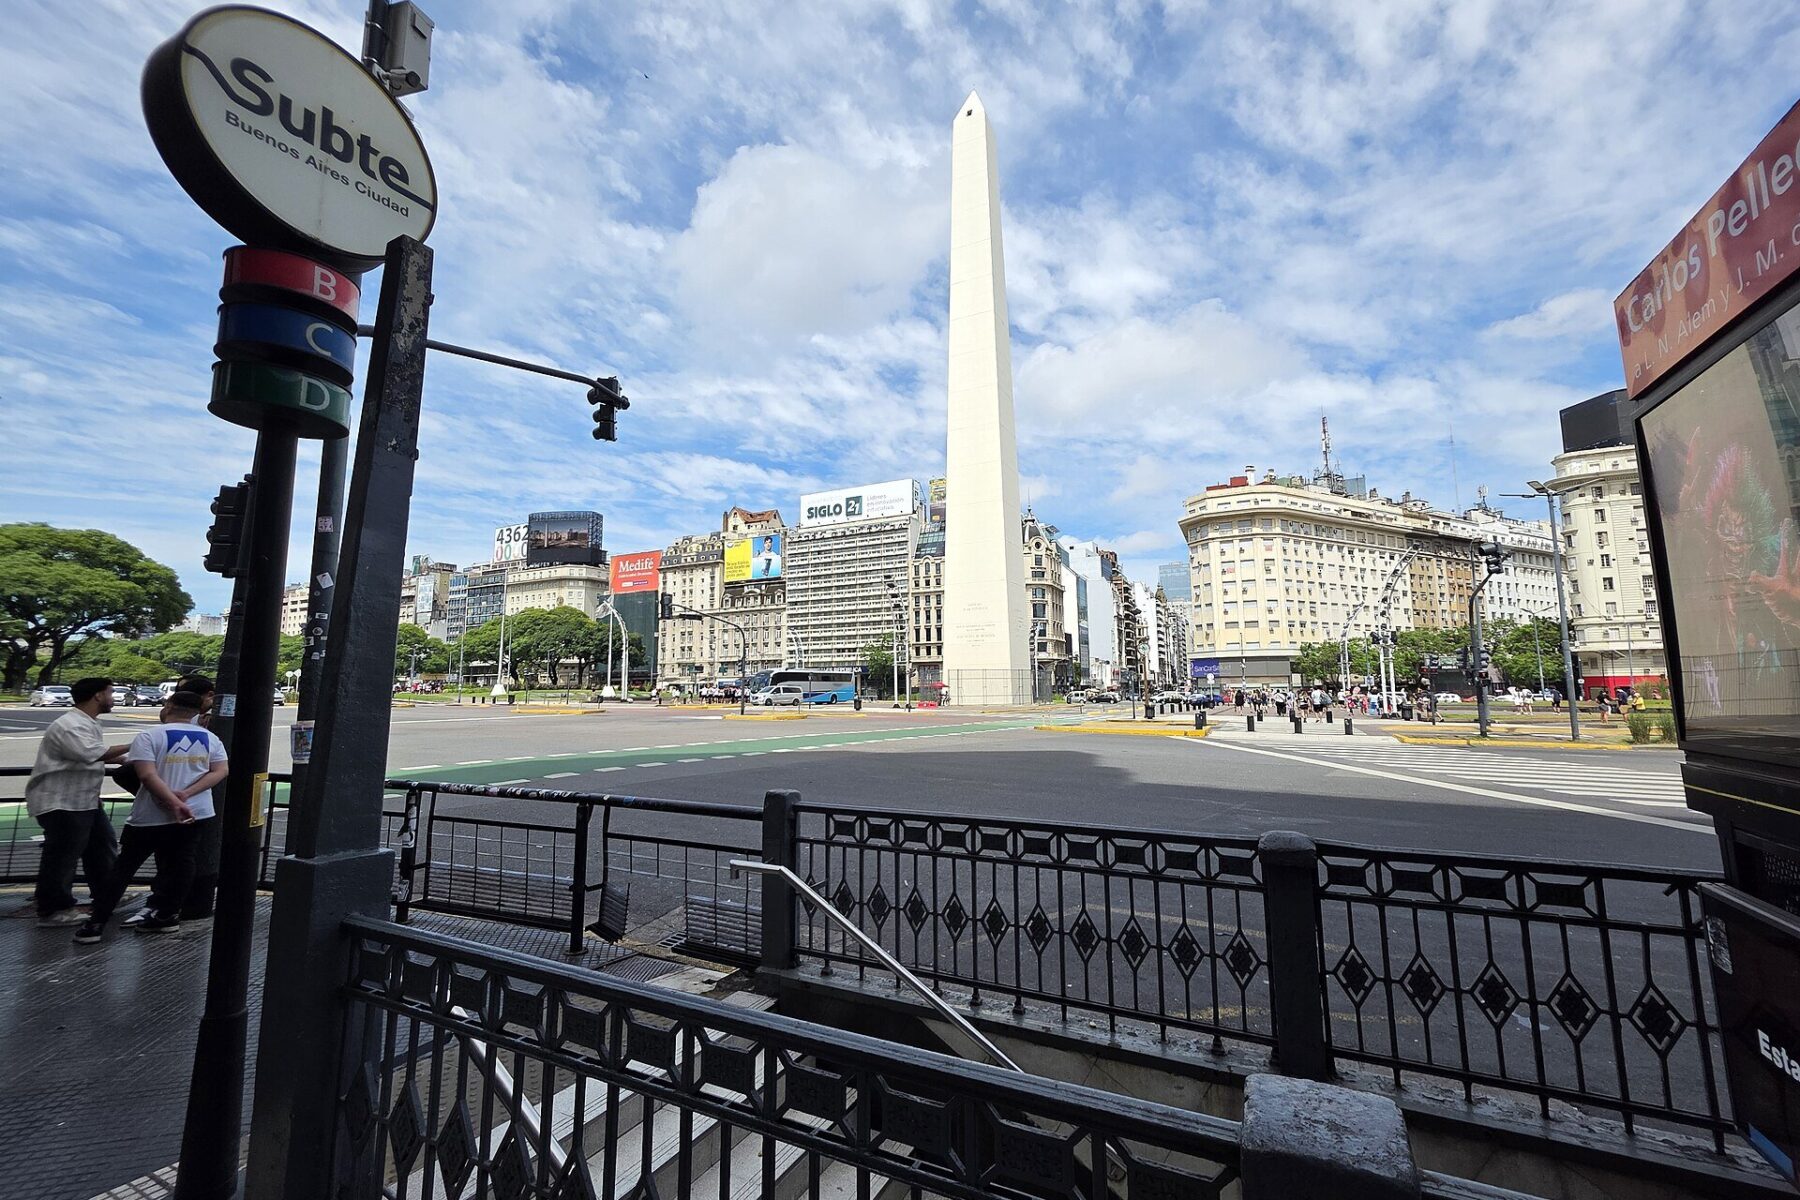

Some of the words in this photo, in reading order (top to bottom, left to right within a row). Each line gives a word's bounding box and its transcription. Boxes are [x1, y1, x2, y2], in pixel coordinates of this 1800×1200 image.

[226, 55, 412, 192] Subte
[225, 109, 300, 160] Buenos
[305, 154, 350, 186] Aires
[354, 180, 410, 218] Ciudad
[312, 265, 337, 302] B
[1626, 242, 1701, 333] Carlos
[1632, 361, 1642, 379] a
[1644, 351, 1656, 369] L.
[1658, 337, 1673, 358] N.
[1677, 296, 1716, 345] Alem
[1721, 282, 1731, 312] y
[1736, 266, 1751, 295] J.
[1754, 237, 1785, 277] M.
[305, 322, 334, 357] C
[299, 375, 331, 411] D
[806, 503, 843, 519] SIGLO
[847, 500, 860, 515] 21
[496, 524, 529, 544] 4362
[618, 557, 654, 573] Medifé
[1757, 1028, 1800, 1083] Esta
